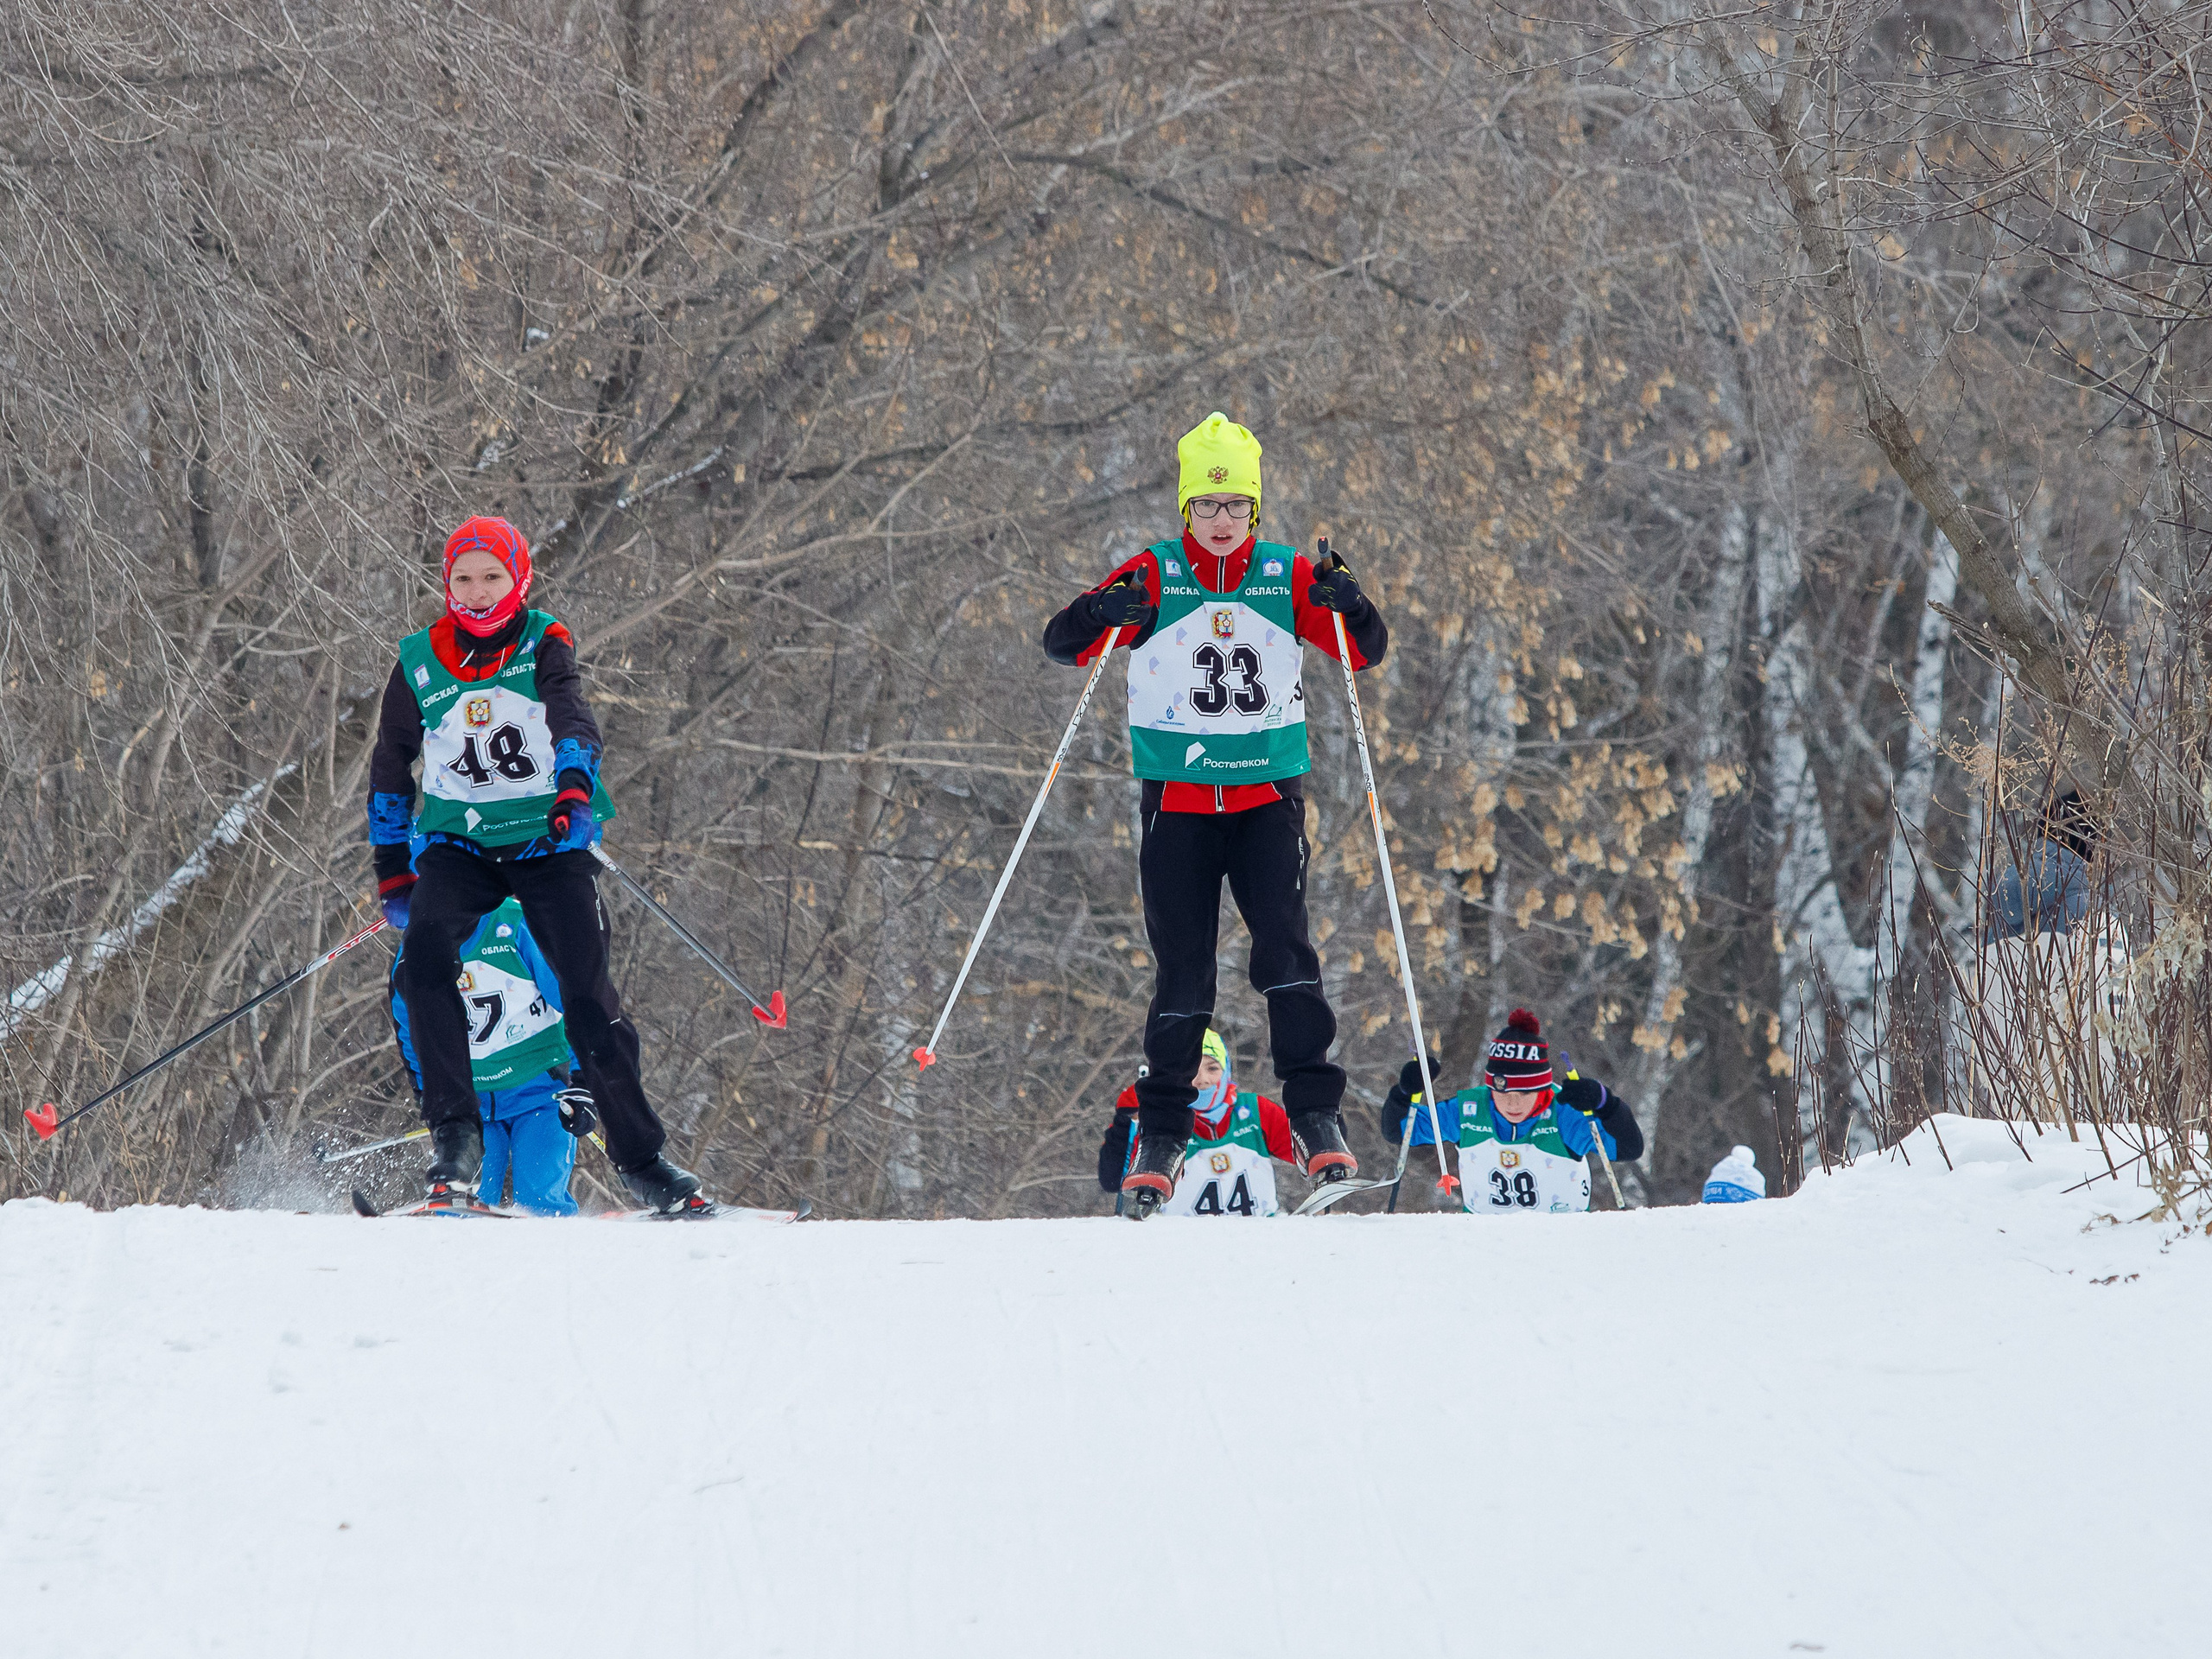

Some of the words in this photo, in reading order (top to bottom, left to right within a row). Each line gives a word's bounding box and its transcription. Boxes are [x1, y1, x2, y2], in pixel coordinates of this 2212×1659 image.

[1162, 586, 1200, 596] ОМСКА
[1244, 586, 1291, 596] ОБЛАСТЬ
[1190, 642, 1270, 717] 33
[446, 721, 540, 788] 48
[1203, 757, 1269, 769] Ростелеком
[465, 990, 505, 1046] 7
[1489, 1041, 1541, 1061] OSSIA
[1192, 1167, 1258, 1217] 44
[1488, 1167, 1541, 1210] 38
